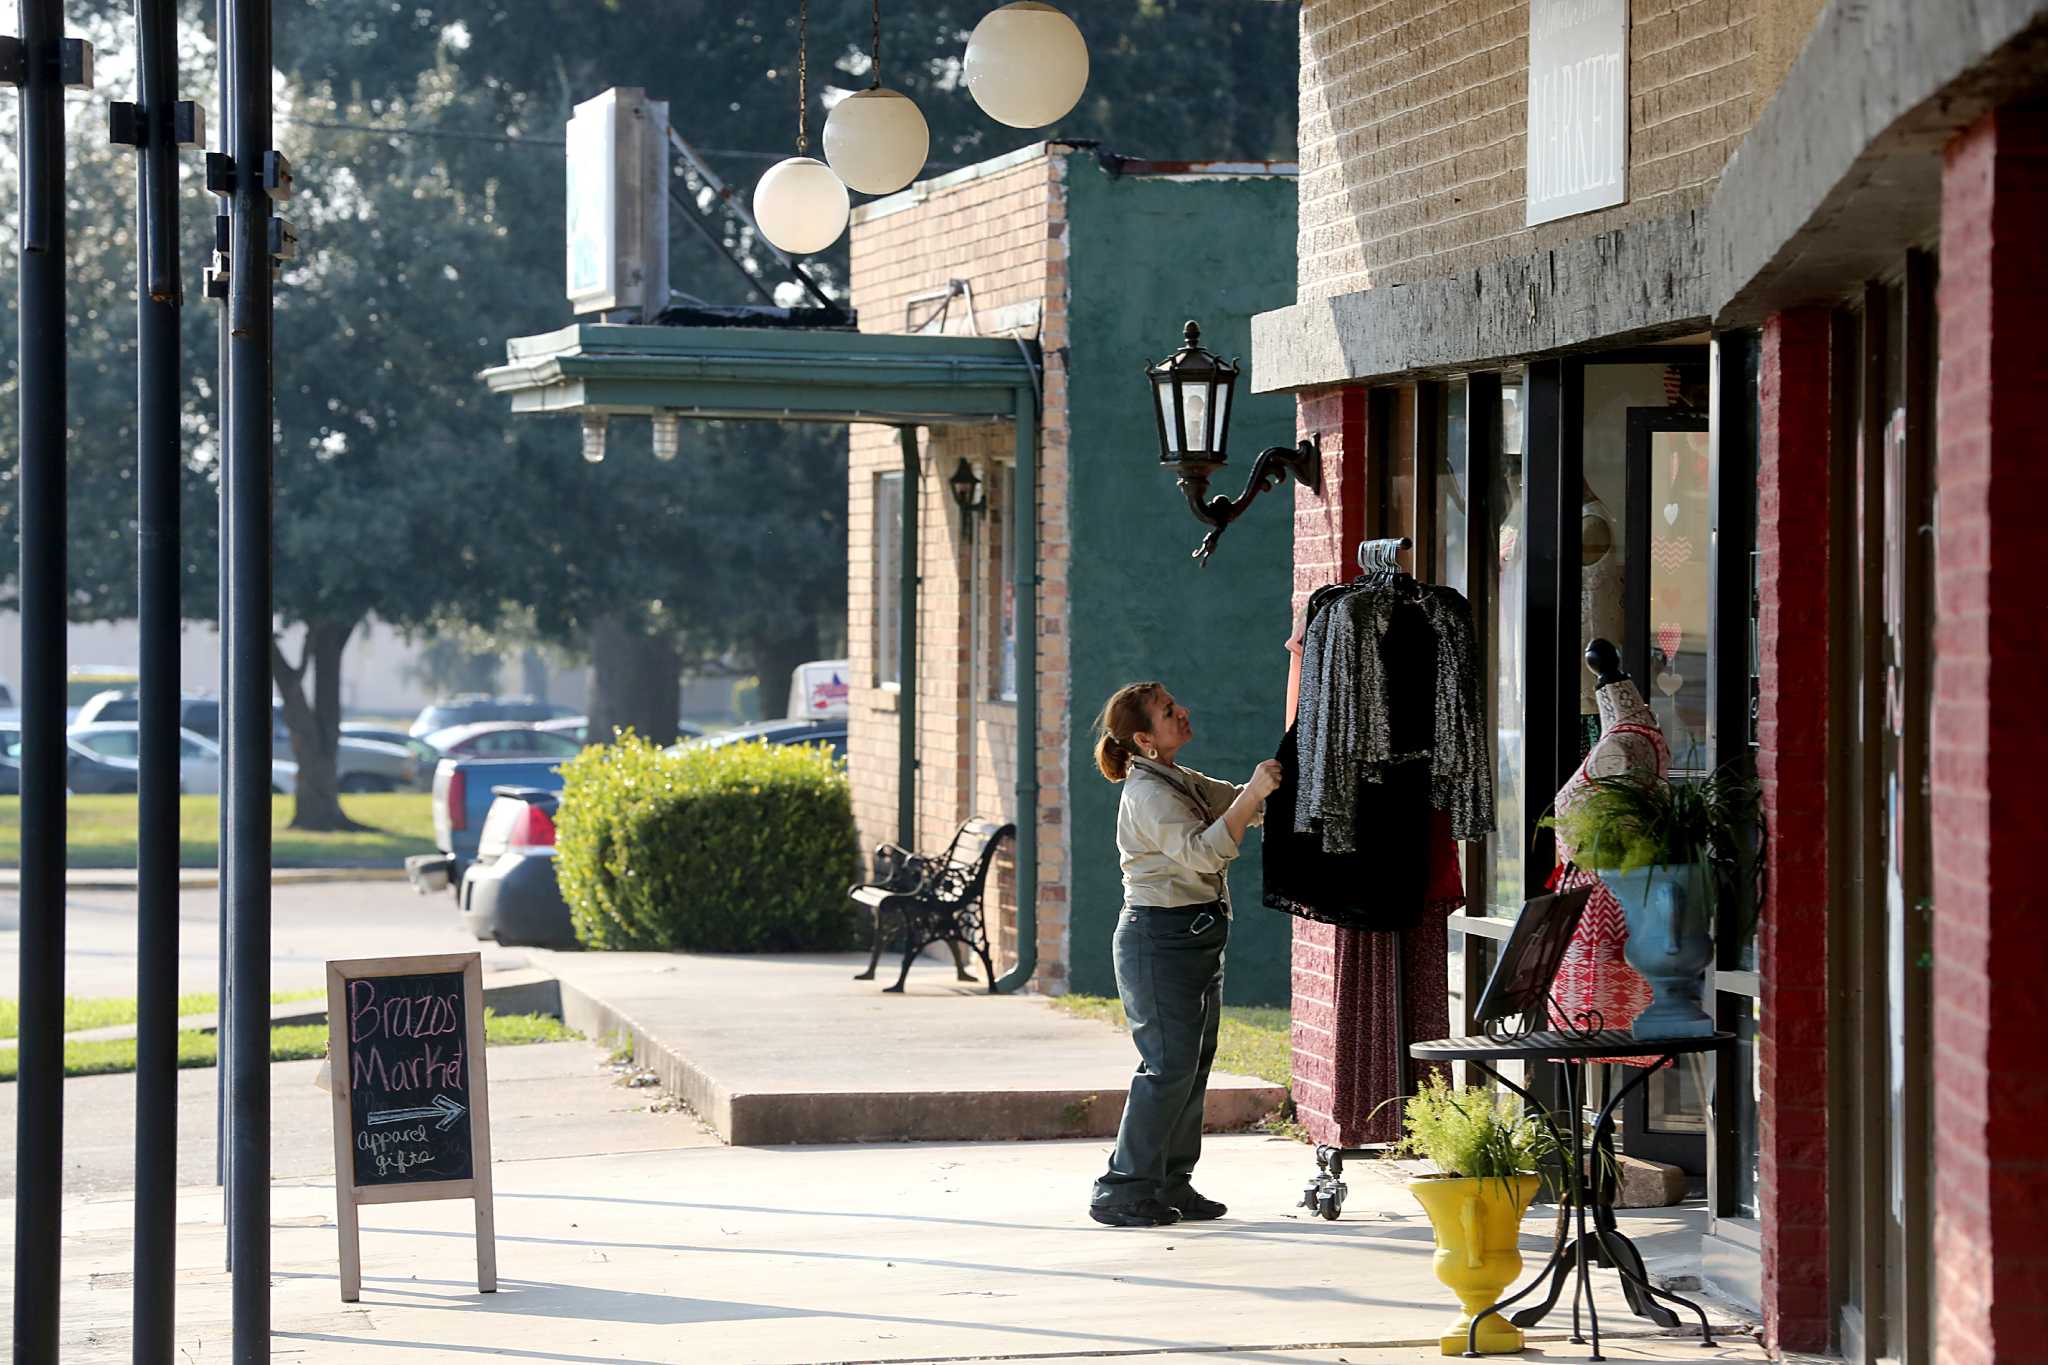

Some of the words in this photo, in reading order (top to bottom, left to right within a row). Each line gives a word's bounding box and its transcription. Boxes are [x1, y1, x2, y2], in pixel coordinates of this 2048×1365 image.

[1531, 54, 1619, 205] MARKET
[350, 980, 459, 1043] Brazos
[352, 1040, 463, 1091] Market
[357, 1124, 430, 1155] apparel
[376, 1150, 435, 1176] gifts
